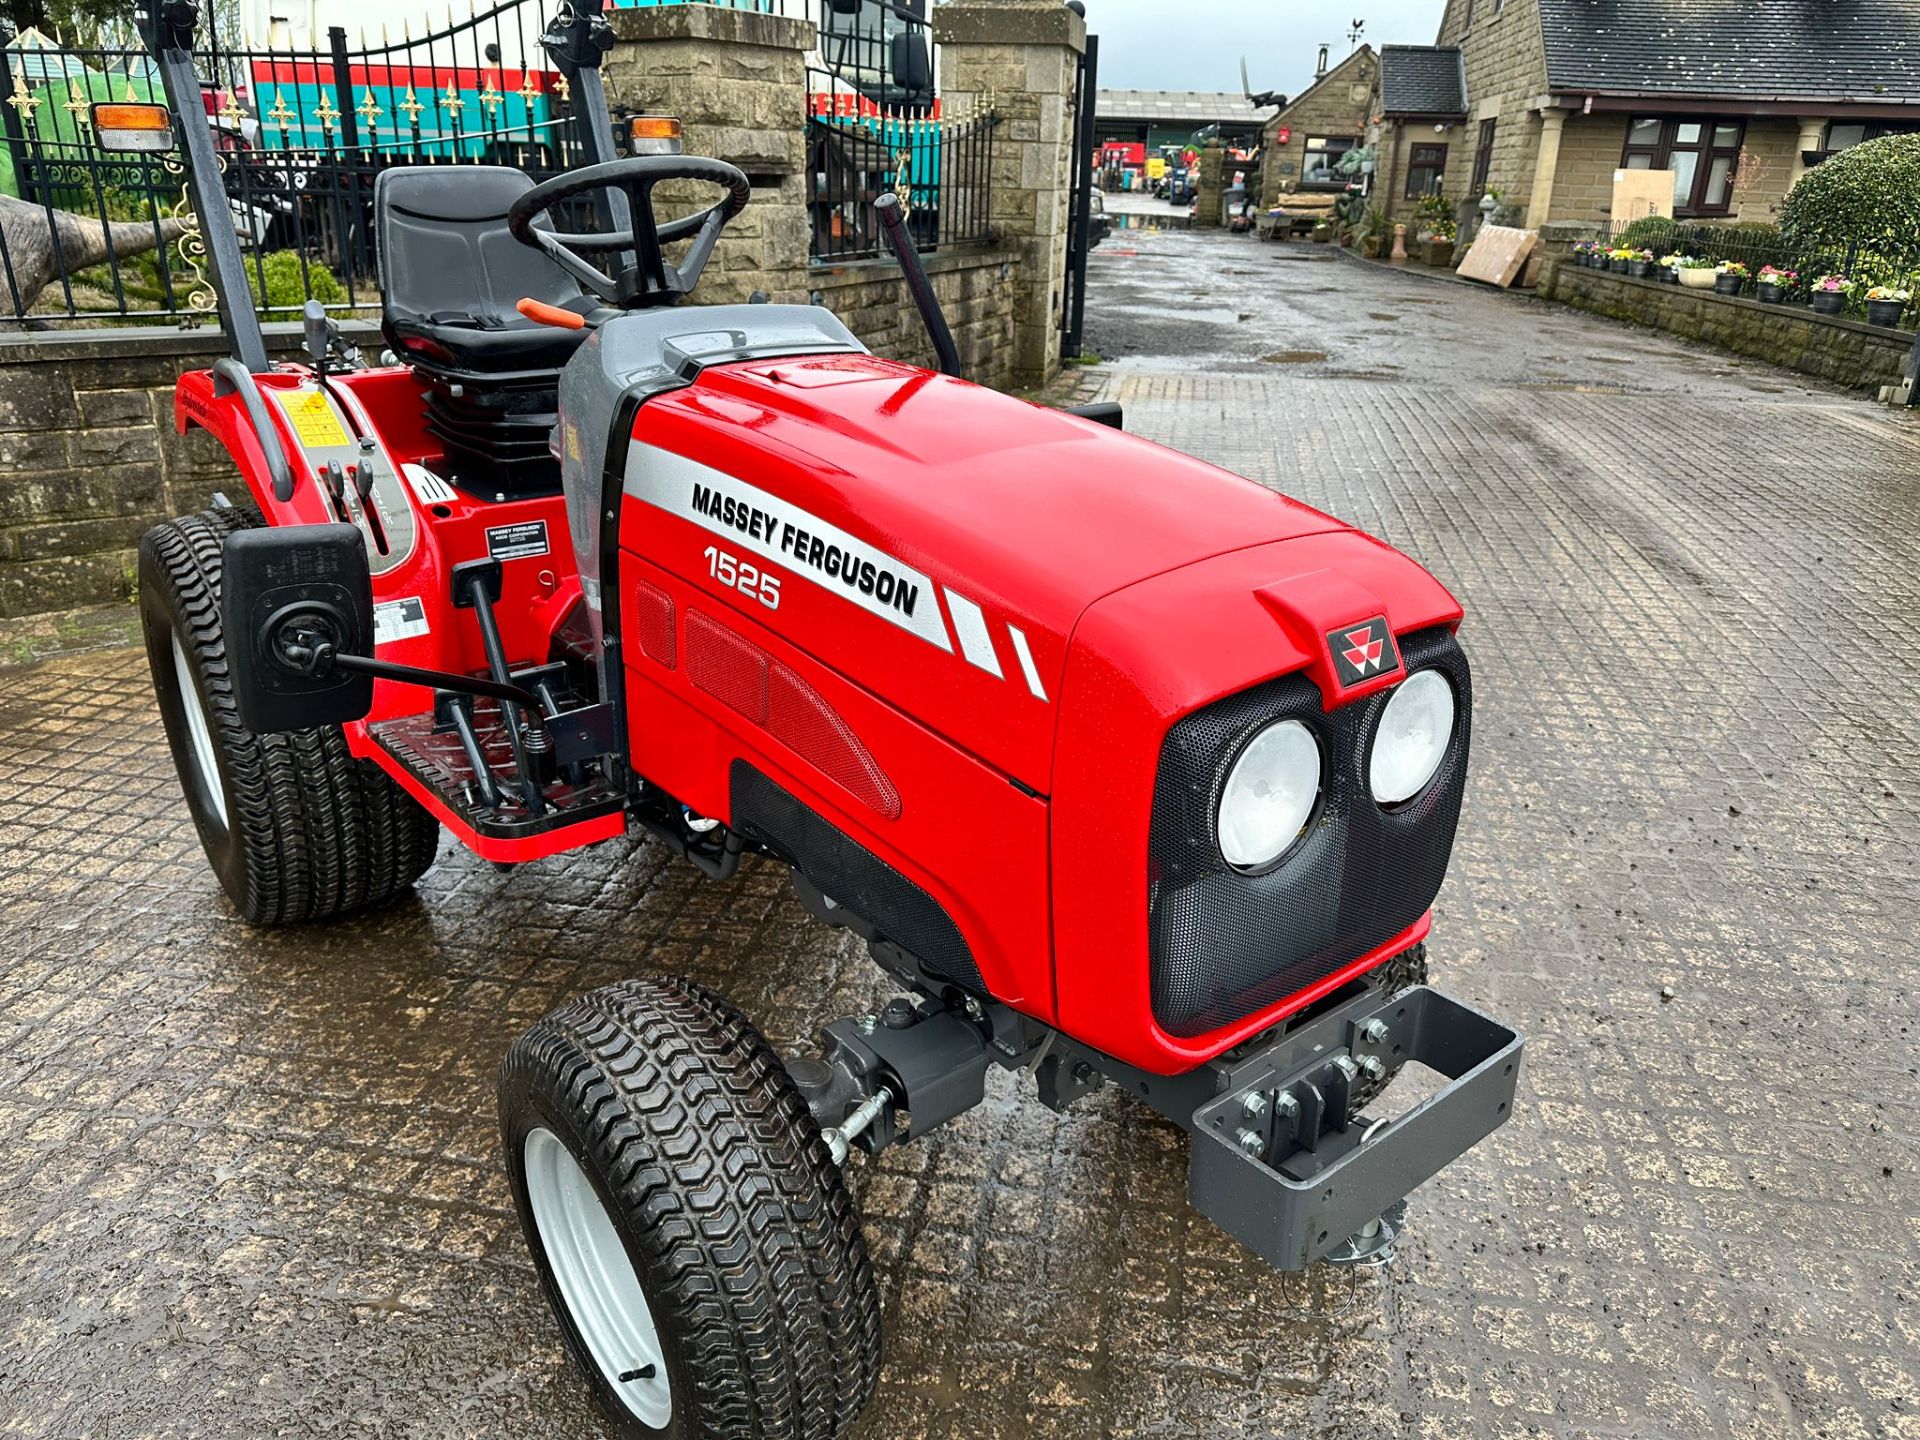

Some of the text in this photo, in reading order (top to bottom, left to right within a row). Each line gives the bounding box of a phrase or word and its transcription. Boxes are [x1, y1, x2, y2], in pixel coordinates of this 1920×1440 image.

[489, 524, 540, 536] MASSEY FERGUSON
[691, 483, 919, 618] MASSEY FERGUSON
[703, 545, 782, 611] 1525
